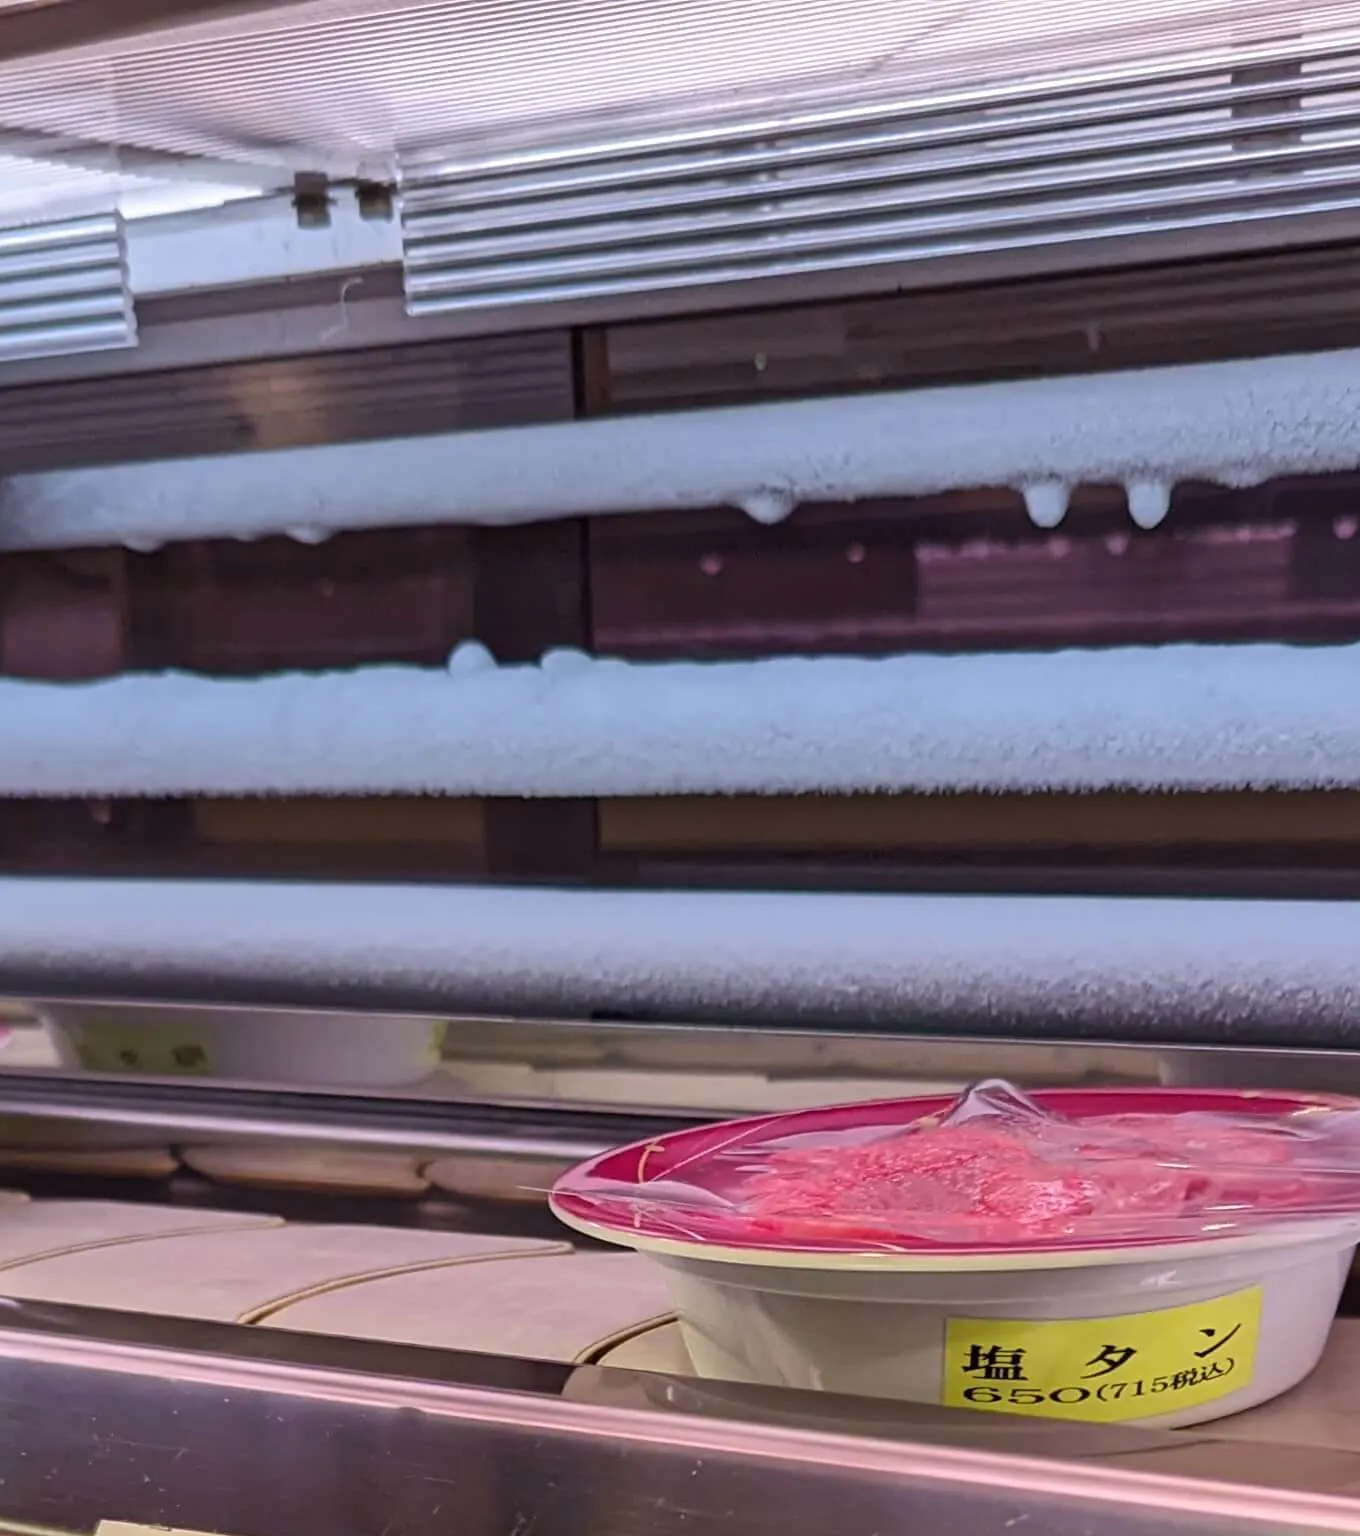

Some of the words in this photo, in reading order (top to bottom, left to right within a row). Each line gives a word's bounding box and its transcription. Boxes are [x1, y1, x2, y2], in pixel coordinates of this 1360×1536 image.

[961, 1322, 1242, 1382] 塩タン
[962, 1356, 1236, 1406] 650(715税込)
